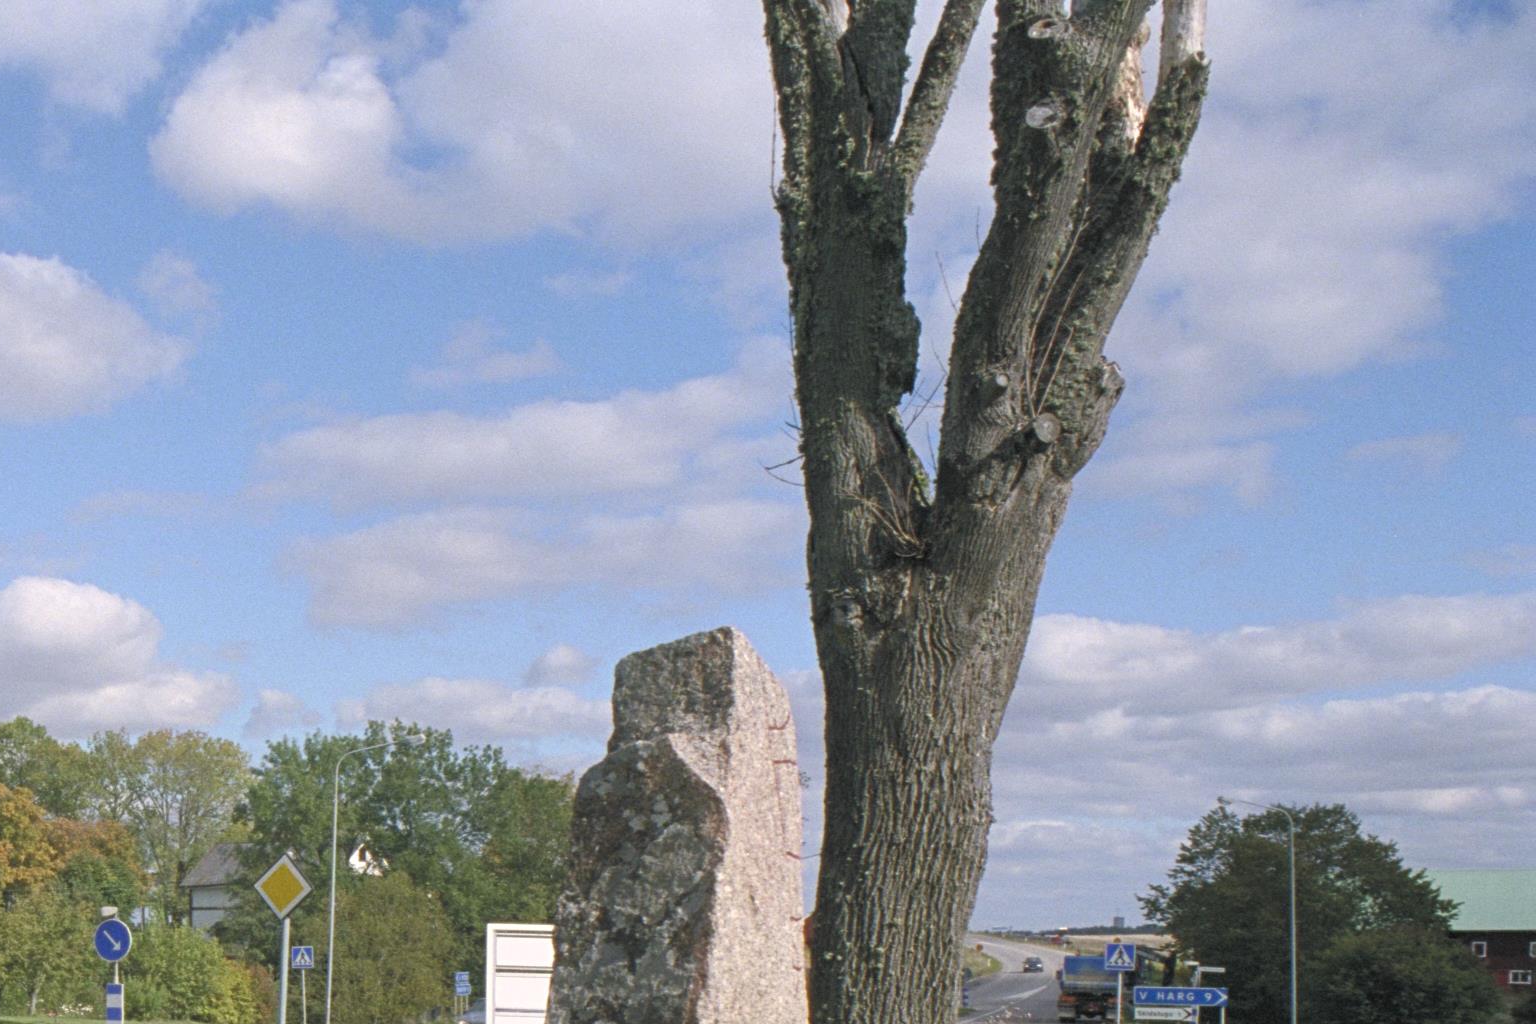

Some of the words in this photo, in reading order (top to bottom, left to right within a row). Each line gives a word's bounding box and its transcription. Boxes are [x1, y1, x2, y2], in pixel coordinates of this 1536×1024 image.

[1139, 991, 1148, 1000] V
[1157, 991, 1195, 1001] HARG
[1204, 992, 1213, 1002] 9
